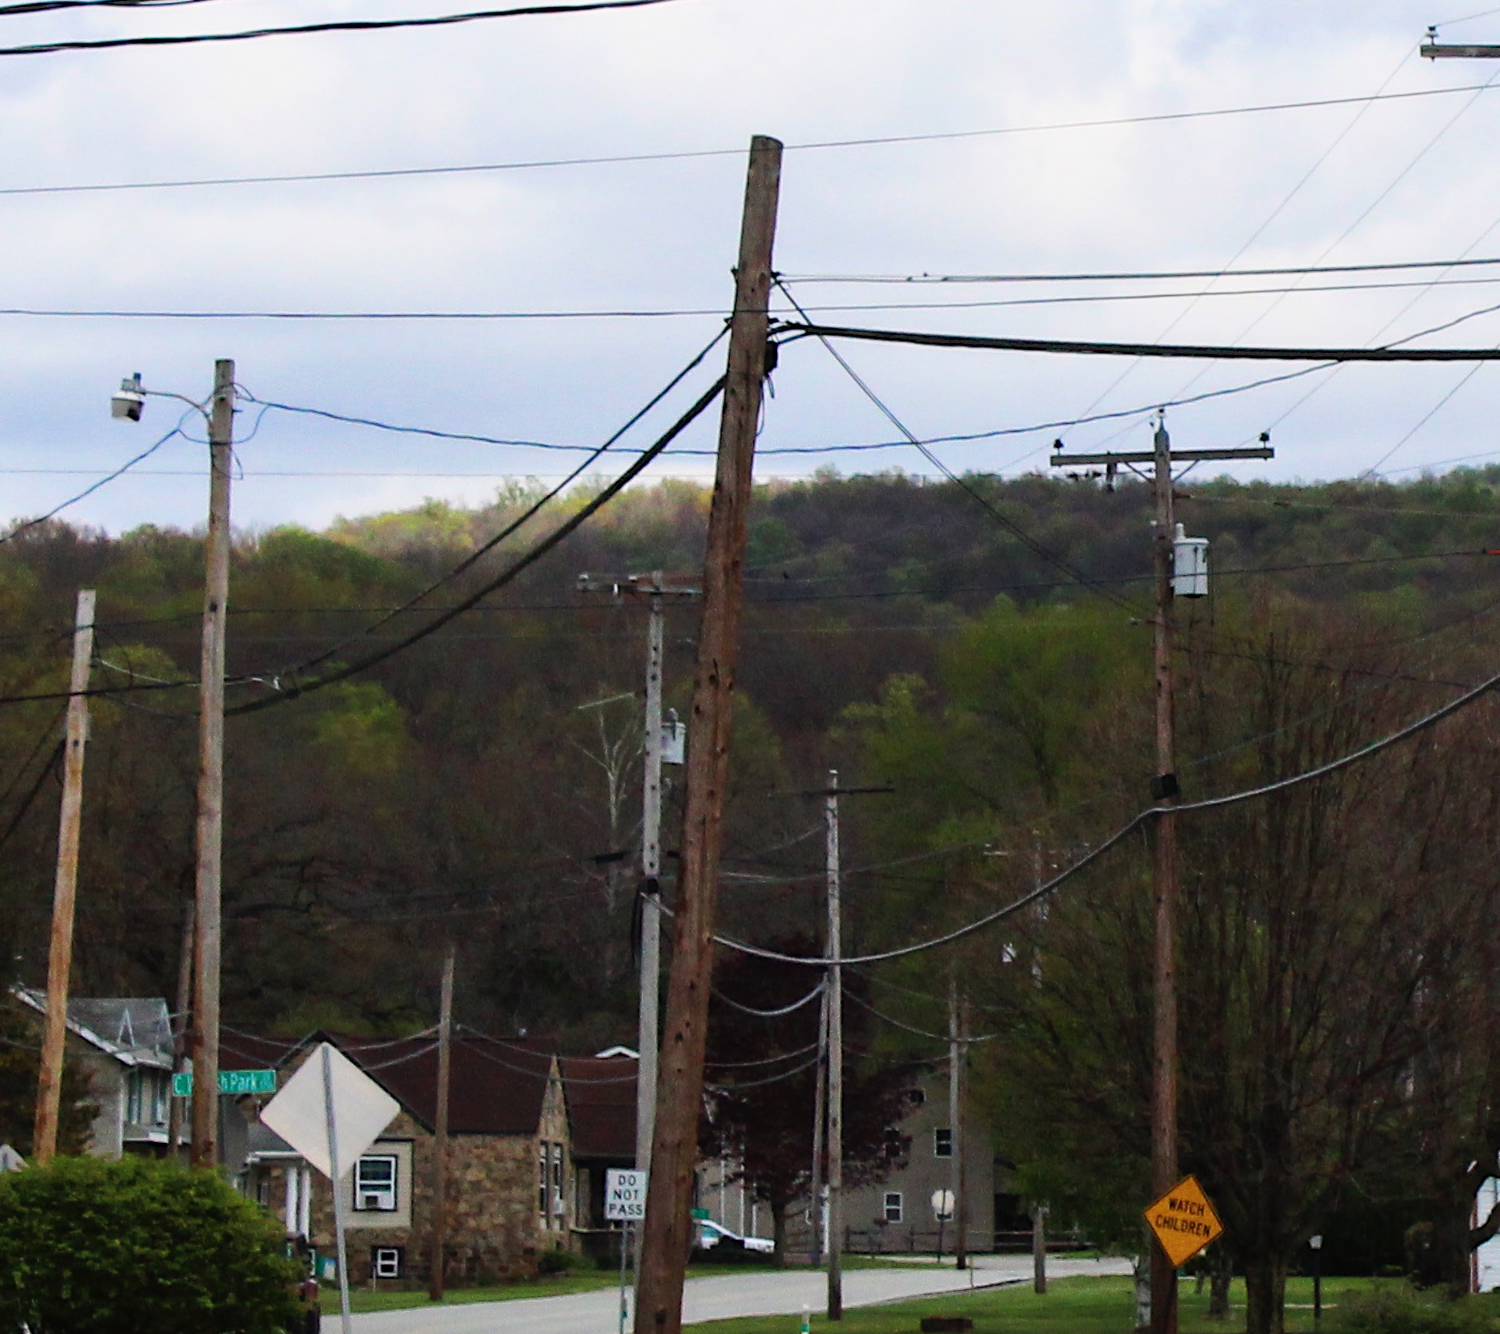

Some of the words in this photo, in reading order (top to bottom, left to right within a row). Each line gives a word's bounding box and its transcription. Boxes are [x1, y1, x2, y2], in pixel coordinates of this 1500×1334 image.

[230, 1072, 257, 1091] Park
[618, 1174, 636, 1186] DO
[613, 1189, 639, 1200] NOT
[609, 1203, 643, 1216] PASS
[1169, 1198, 1205, 1217] WATCH
[1155, 1214, 1212, 1238] CHILDREN
